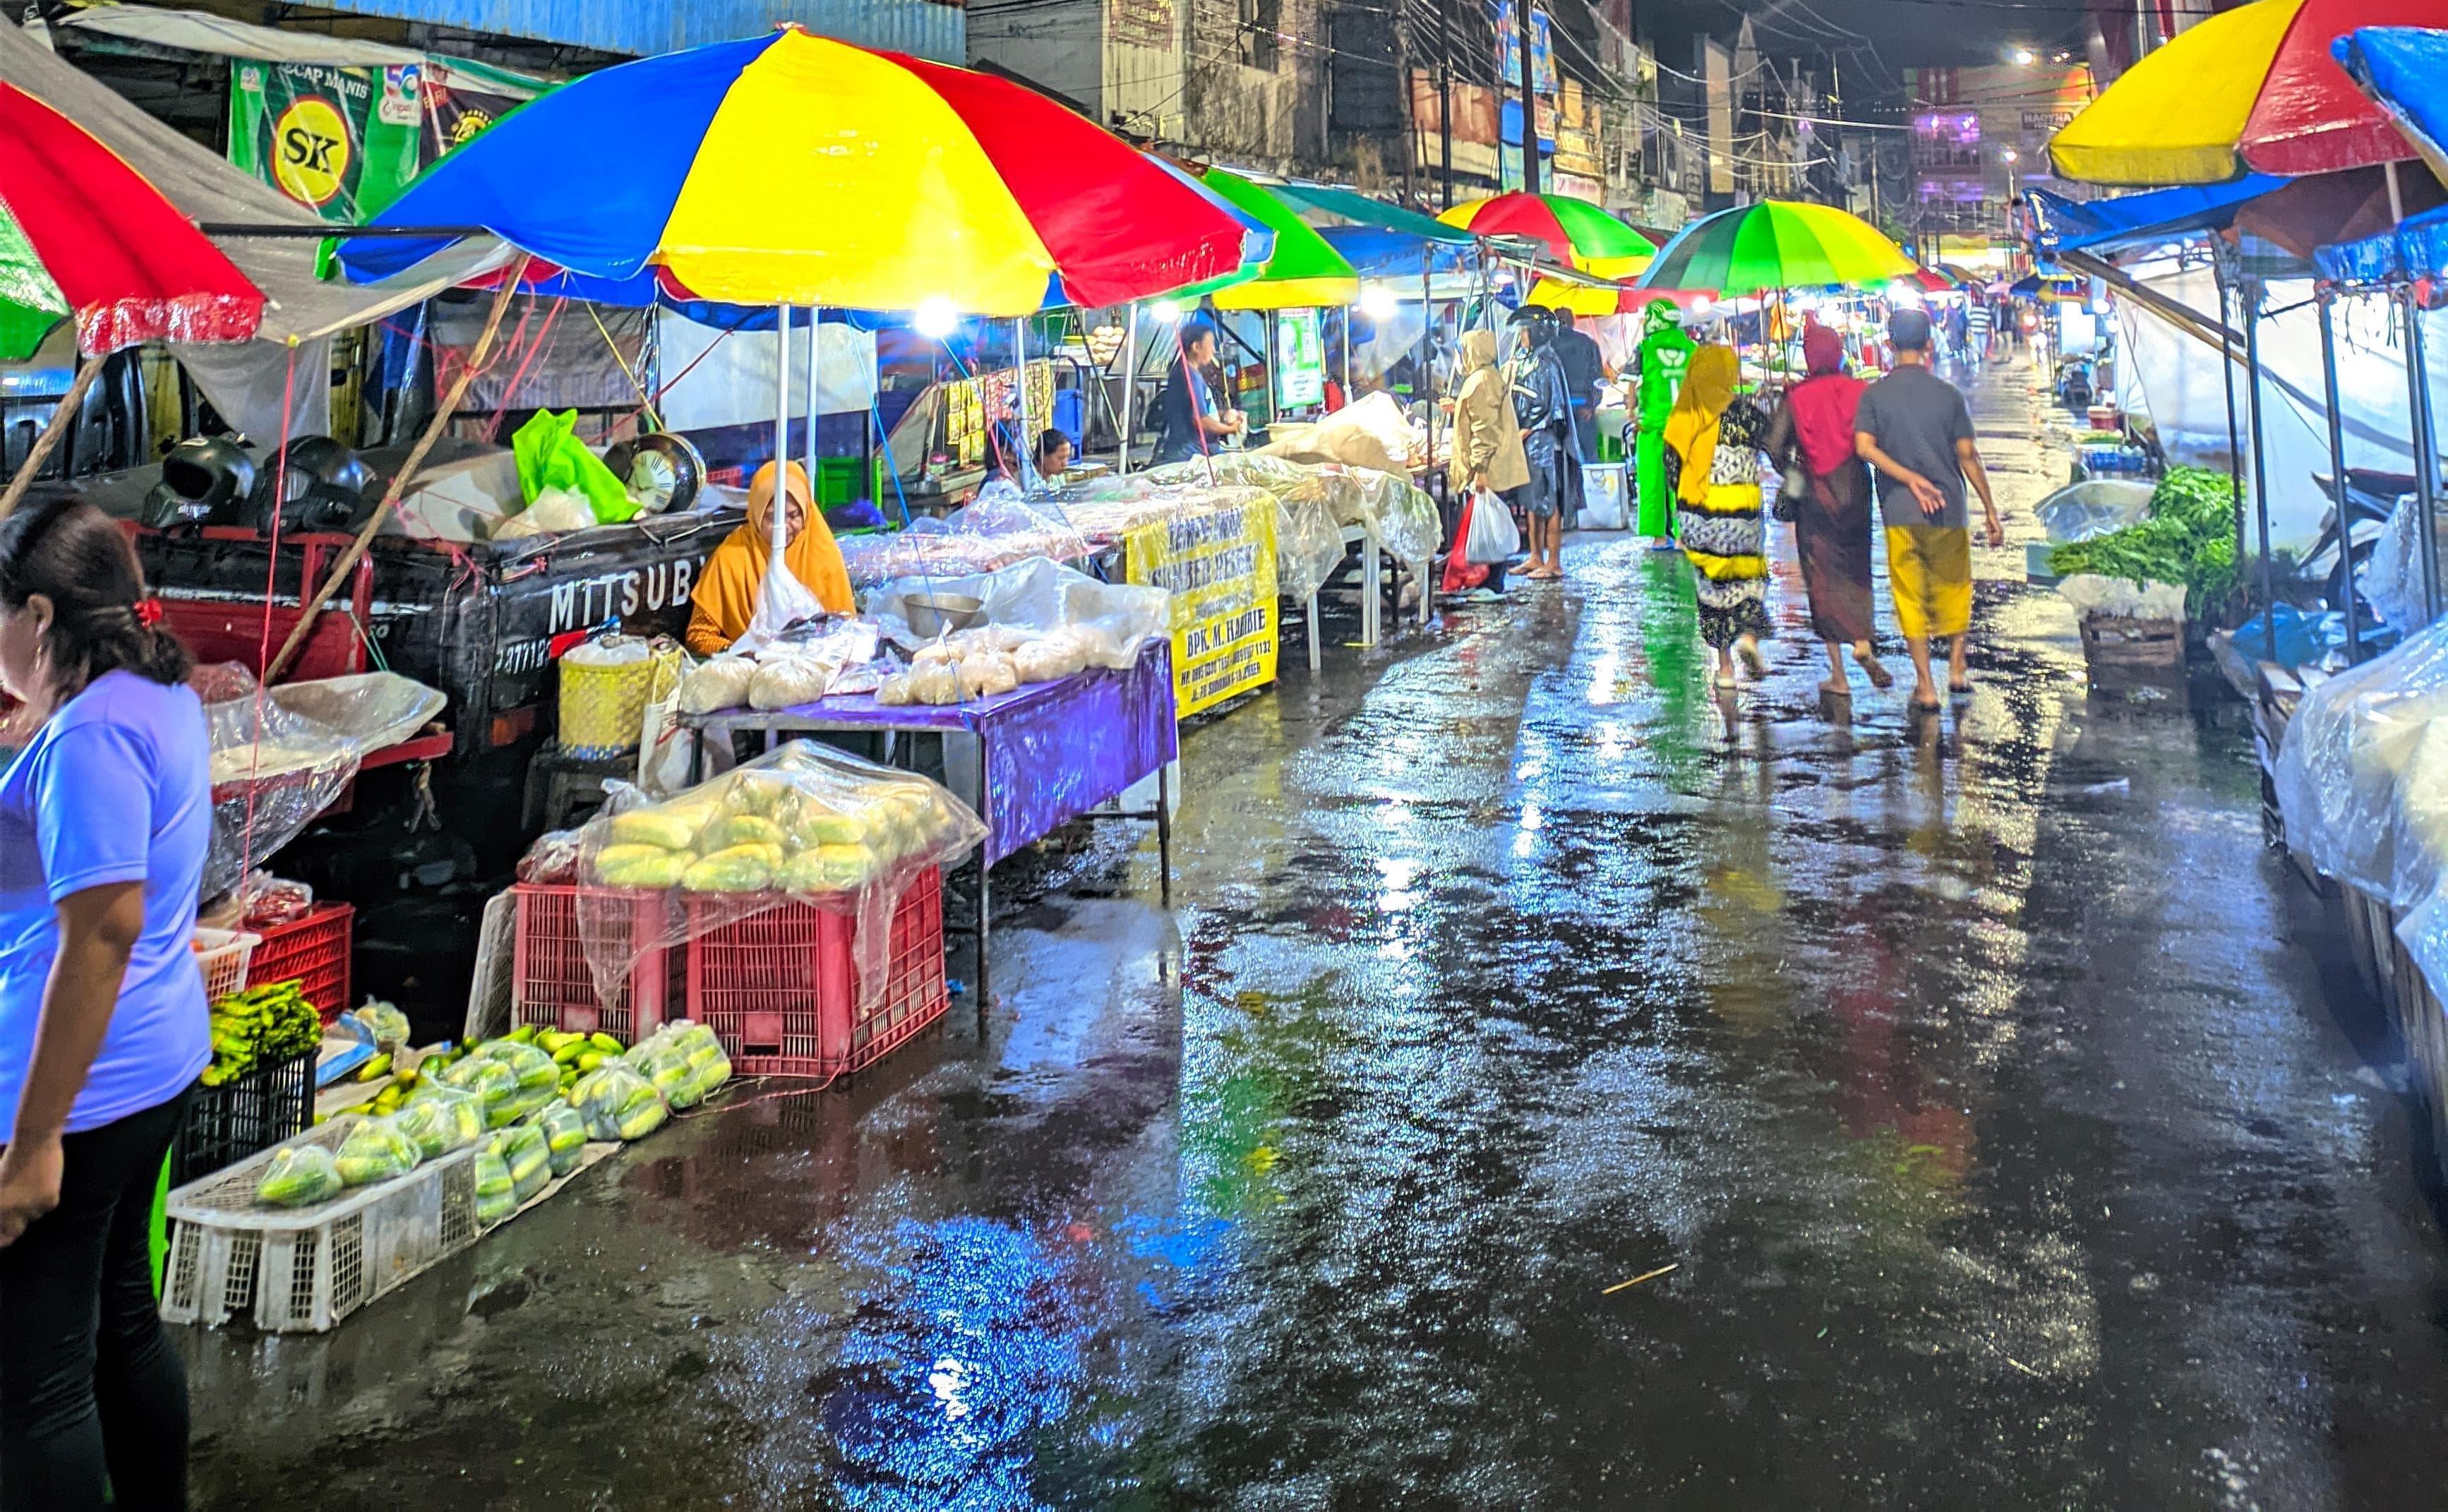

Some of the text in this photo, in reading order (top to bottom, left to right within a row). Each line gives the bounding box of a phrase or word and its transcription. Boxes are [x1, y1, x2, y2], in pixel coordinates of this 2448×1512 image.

[325, 73, 369, 99] MANIS
[284, 128, 339, 175] SK
[1213, 625, 1225, 648] M.
